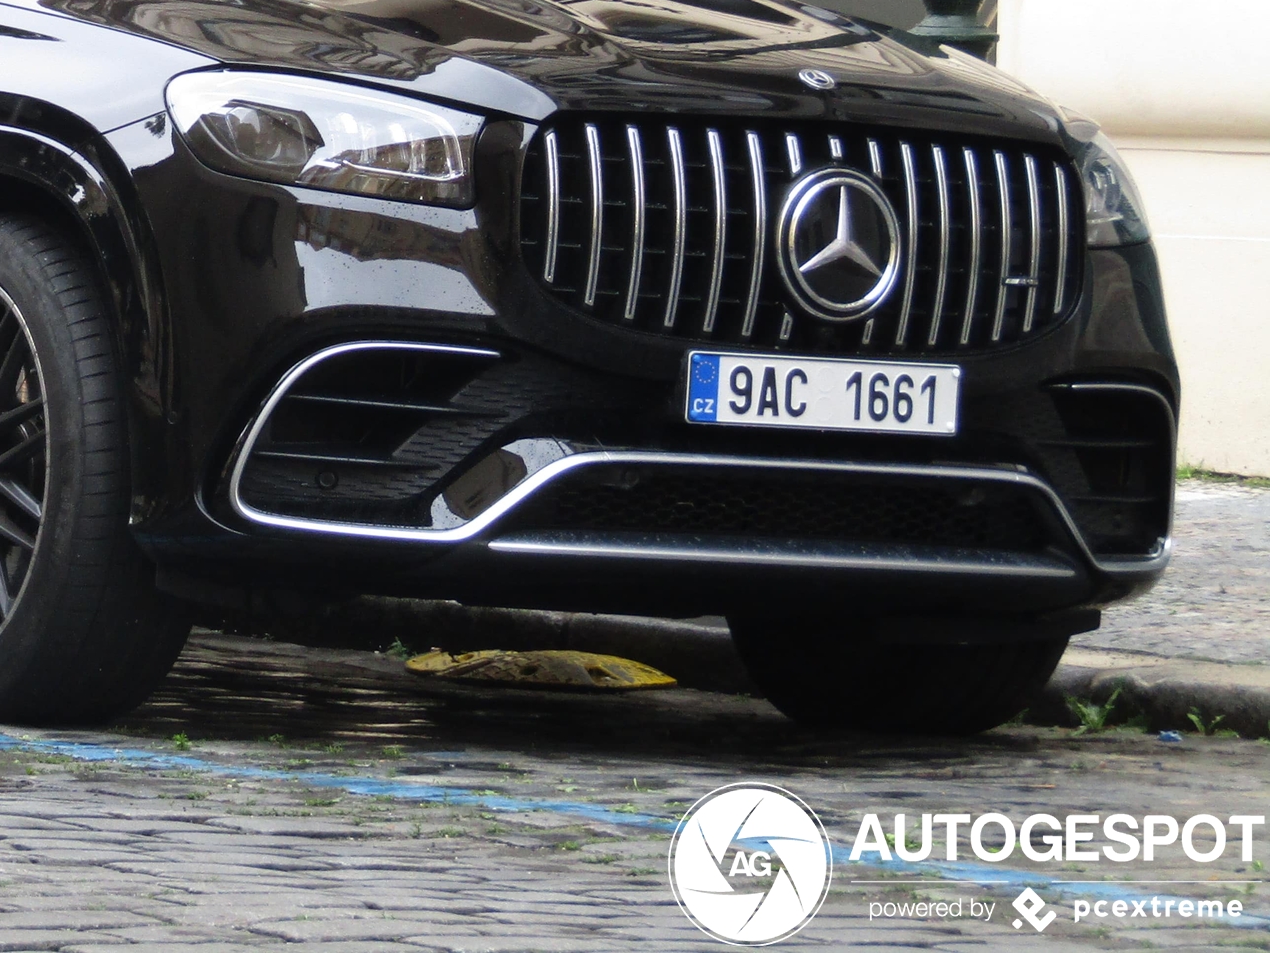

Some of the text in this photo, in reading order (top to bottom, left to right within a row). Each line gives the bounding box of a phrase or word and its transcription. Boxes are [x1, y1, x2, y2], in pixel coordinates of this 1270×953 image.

[693, 398, 713, 414] CZ
[729, 365, 937, 424] 9AC 1661
